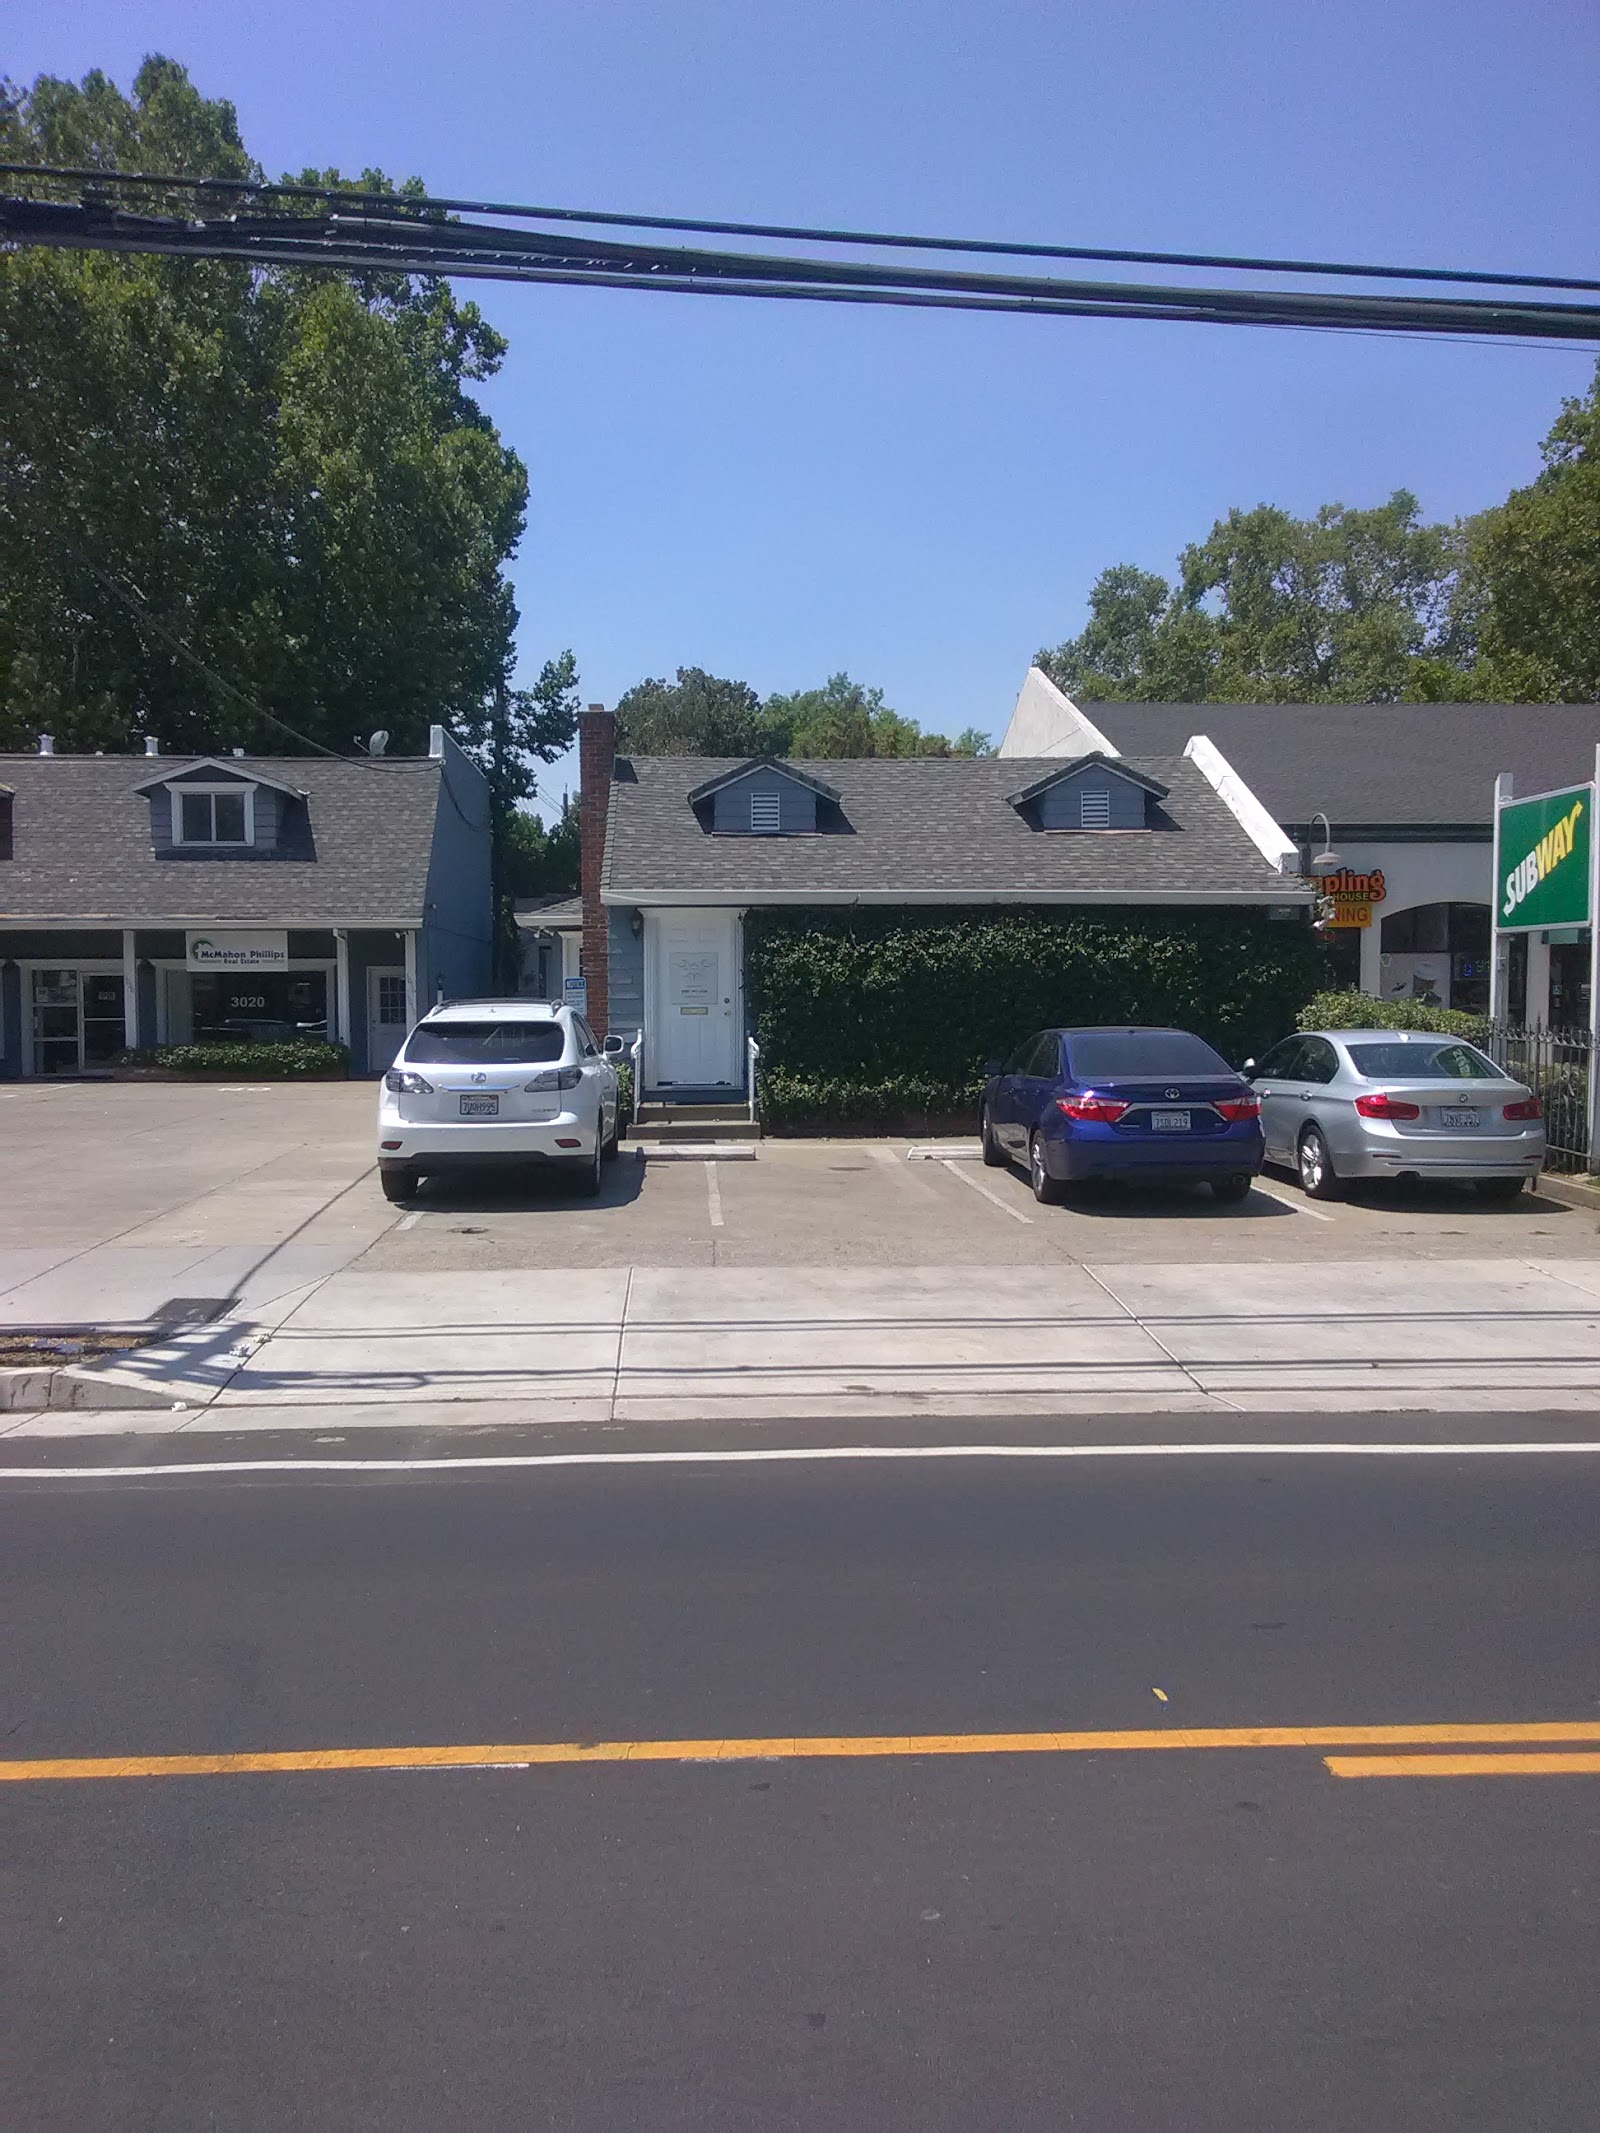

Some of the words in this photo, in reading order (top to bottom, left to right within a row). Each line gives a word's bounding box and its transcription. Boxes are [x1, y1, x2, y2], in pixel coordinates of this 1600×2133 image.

[1503, 800, 1583, 917] SUBWAY
[1333, 892, 1369, 902] HOUSE
[201, 950, 246, 959] McMahon
[250, 950, 285, 960] Phillips
[231, 996, 265, 1008] 3020
